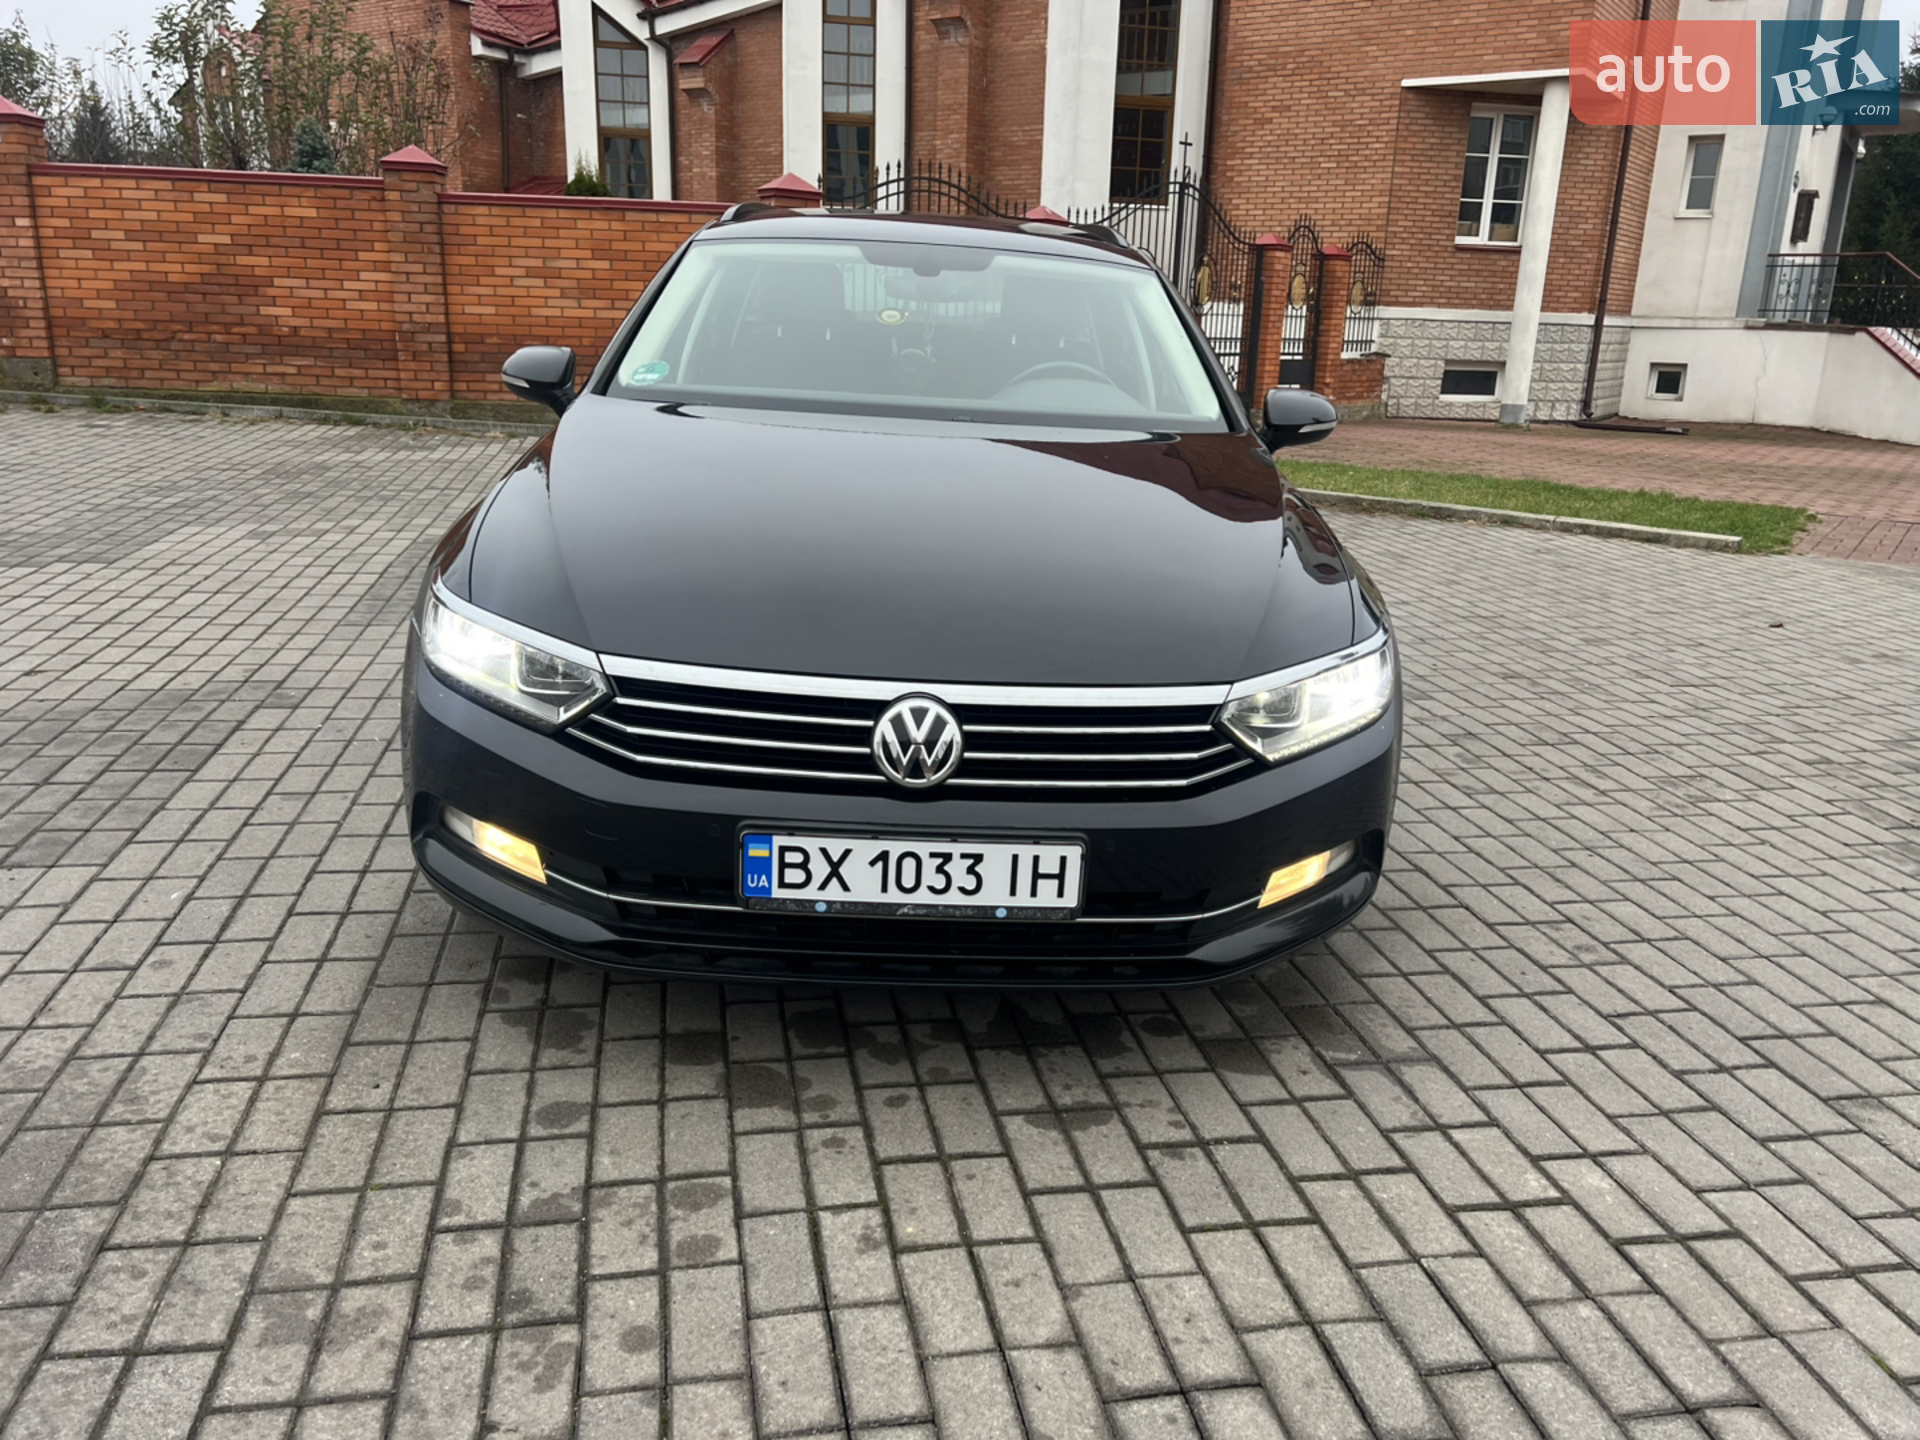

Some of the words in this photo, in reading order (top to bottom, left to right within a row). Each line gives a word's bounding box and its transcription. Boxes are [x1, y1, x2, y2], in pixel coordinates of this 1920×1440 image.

[747, 873, 769, 888] UA
[777, 844, 853, 893] BX
[867, 849, 984, 896] 1033
[1009, 853, 1067, 899] IH
